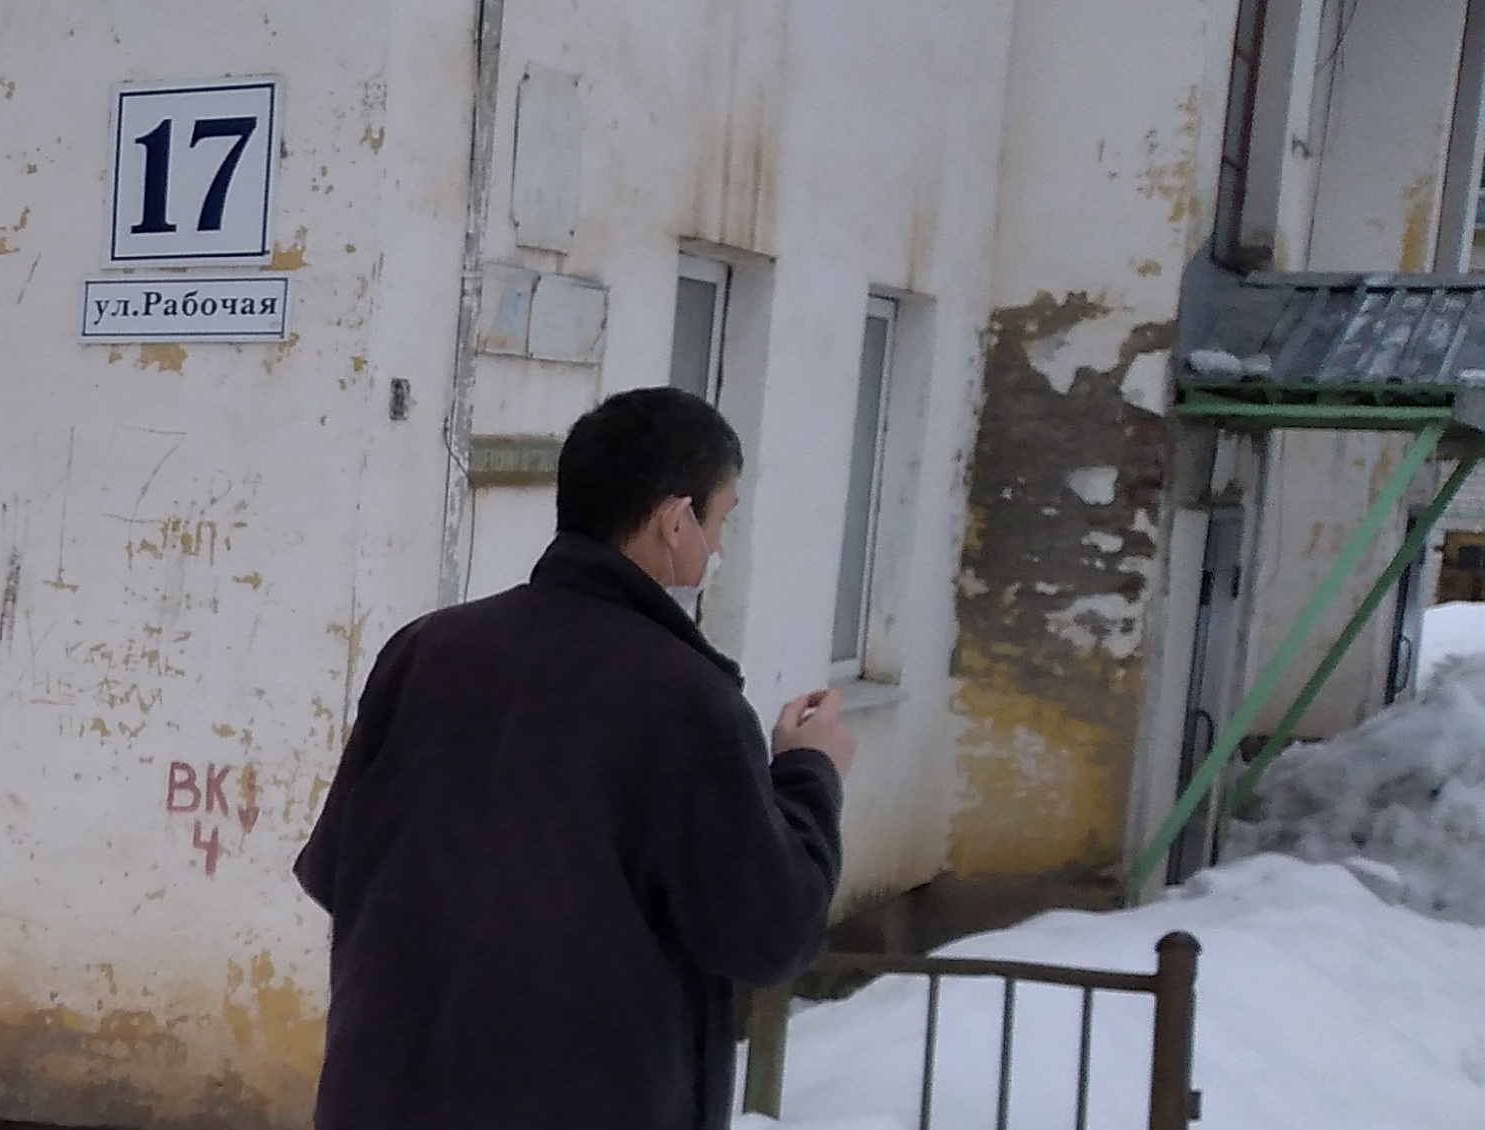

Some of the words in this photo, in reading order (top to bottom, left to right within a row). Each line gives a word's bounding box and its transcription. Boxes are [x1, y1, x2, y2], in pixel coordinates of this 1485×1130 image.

[130, 116, 258, 234] 17
[93, 290, 278, 326] ул.Рабочая
[192, 820, 220, 876] 4
